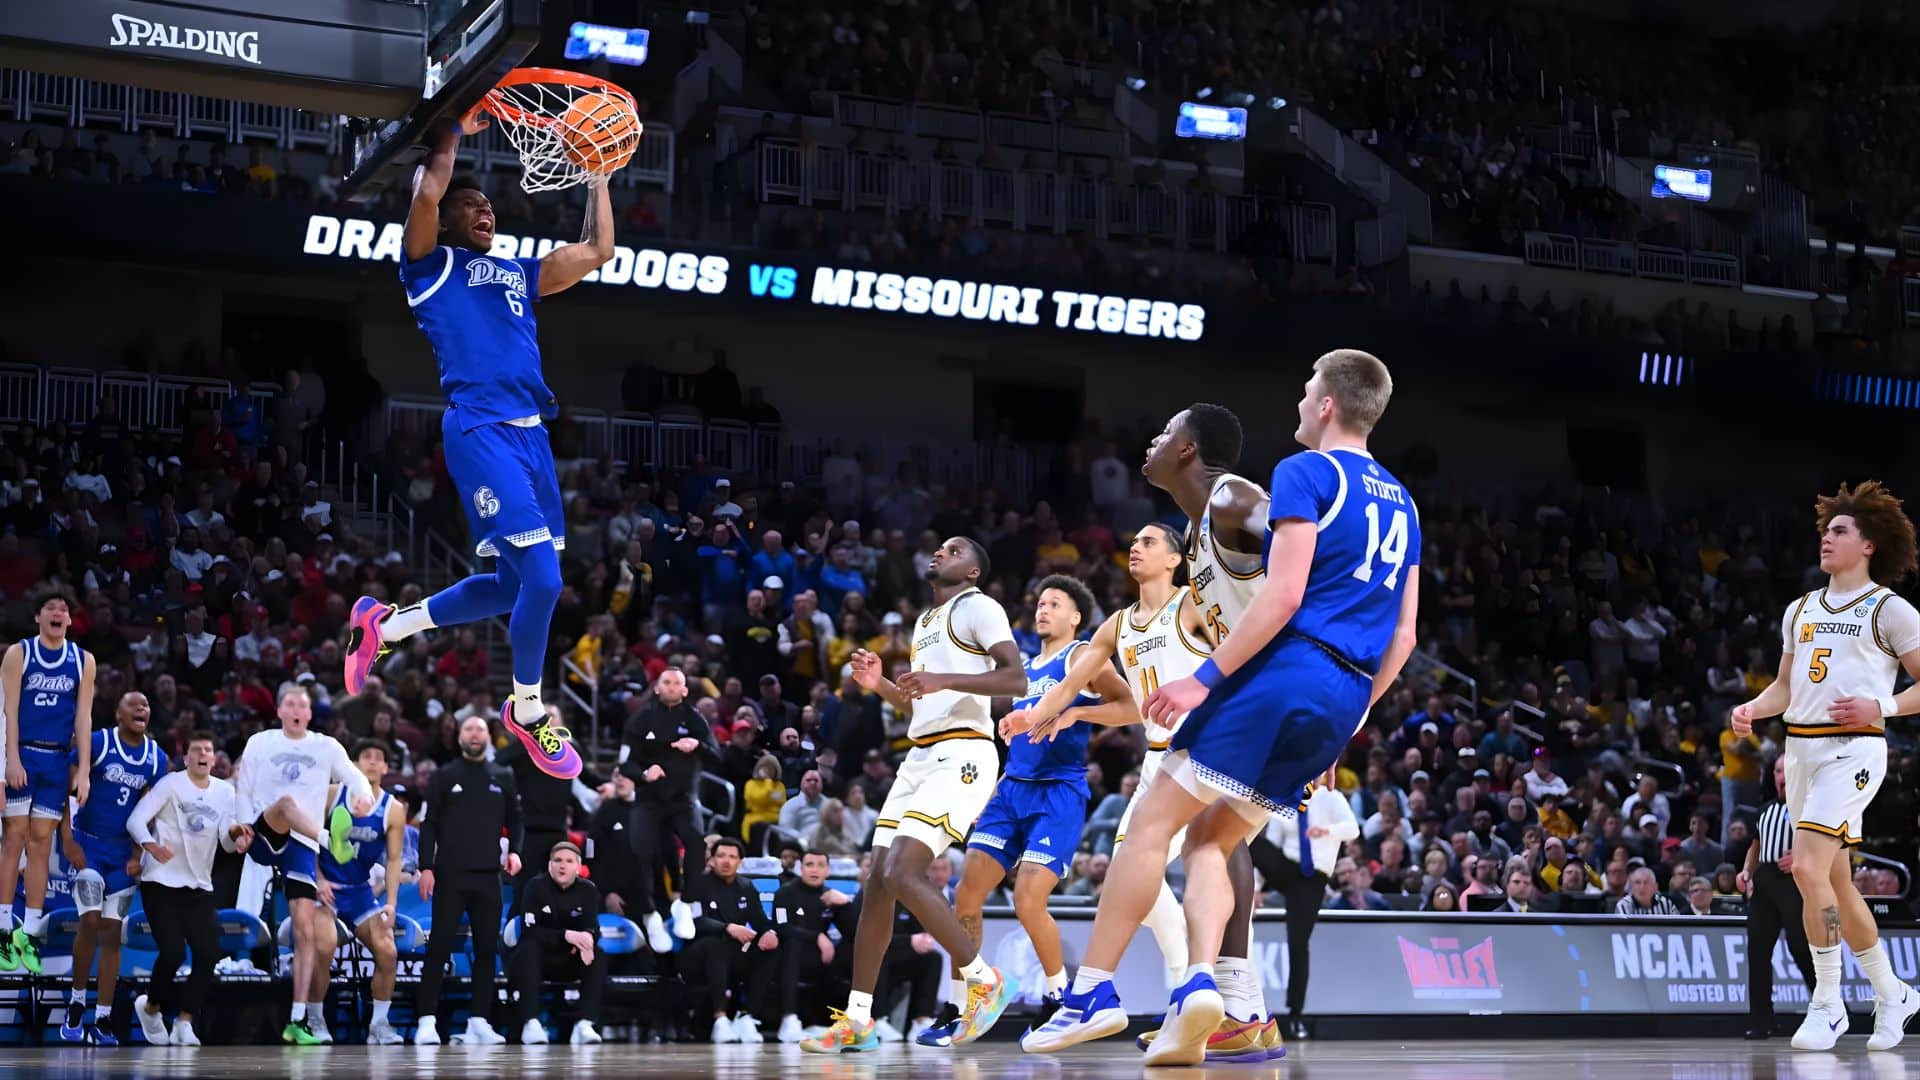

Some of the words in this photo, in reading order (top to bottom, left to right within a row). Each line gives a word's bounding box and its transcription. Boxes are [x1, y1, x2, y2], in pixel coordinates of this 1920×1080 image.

[110, 13, 262, 65] SPALDING
[303, 215, 404, 263] DRA
[484, 233, 730, 294] BUDOGS
[749, 264, 798, 299] VS
[811, 266, 1044, 325] MISSOURI
[1052, 290, 1206, 341] TIGERS
[504, 290, 524, 318] 6
[1361, 473, 1406, 506] STIRTZ
[1352, 502, 1409, 592] 14
[1799, 622, 1862, 643] MISSOURI
[25, 672, 75, 693] Drake
[1808, 648, 1833, 684] 5
[117, 786, 130, 806] 3
[1611, 934, 1717, 979] NCAA
[1668, 983, 1725, 1002] HOSTED
[1728, 984, 1746, 1002] BY
